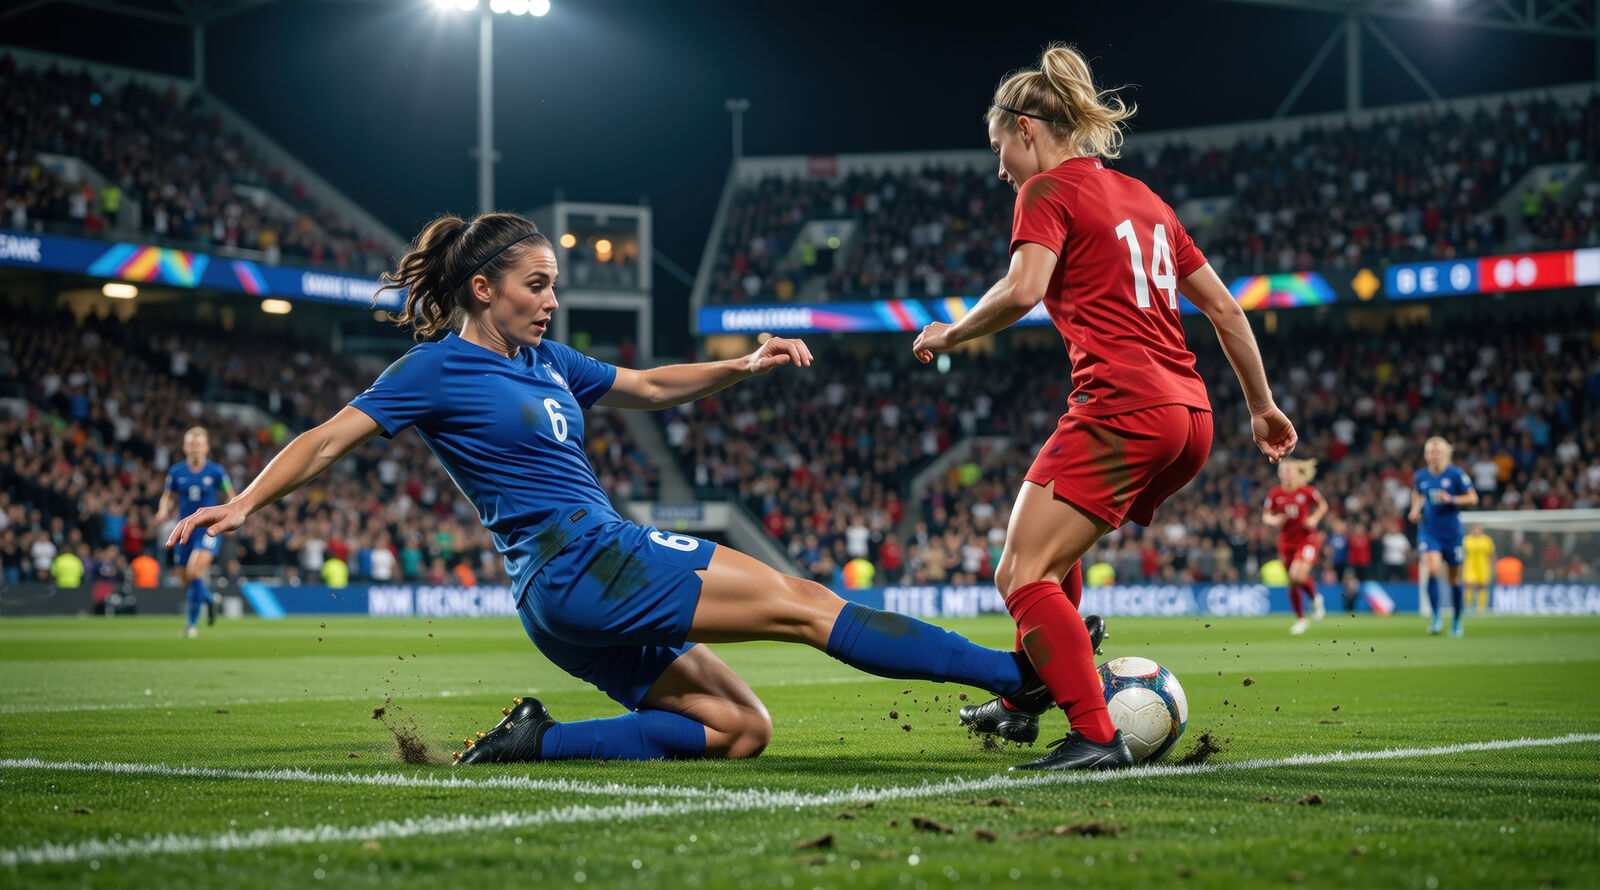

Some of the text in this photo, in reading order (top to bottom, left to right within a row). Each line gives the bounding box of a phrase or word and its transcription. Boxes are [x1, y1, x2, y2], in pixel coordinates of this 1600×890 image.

[1115, 219, 1177, 310] 14
[543, 397, 568, 442] 6
[650, 531, 699, 552] 6
